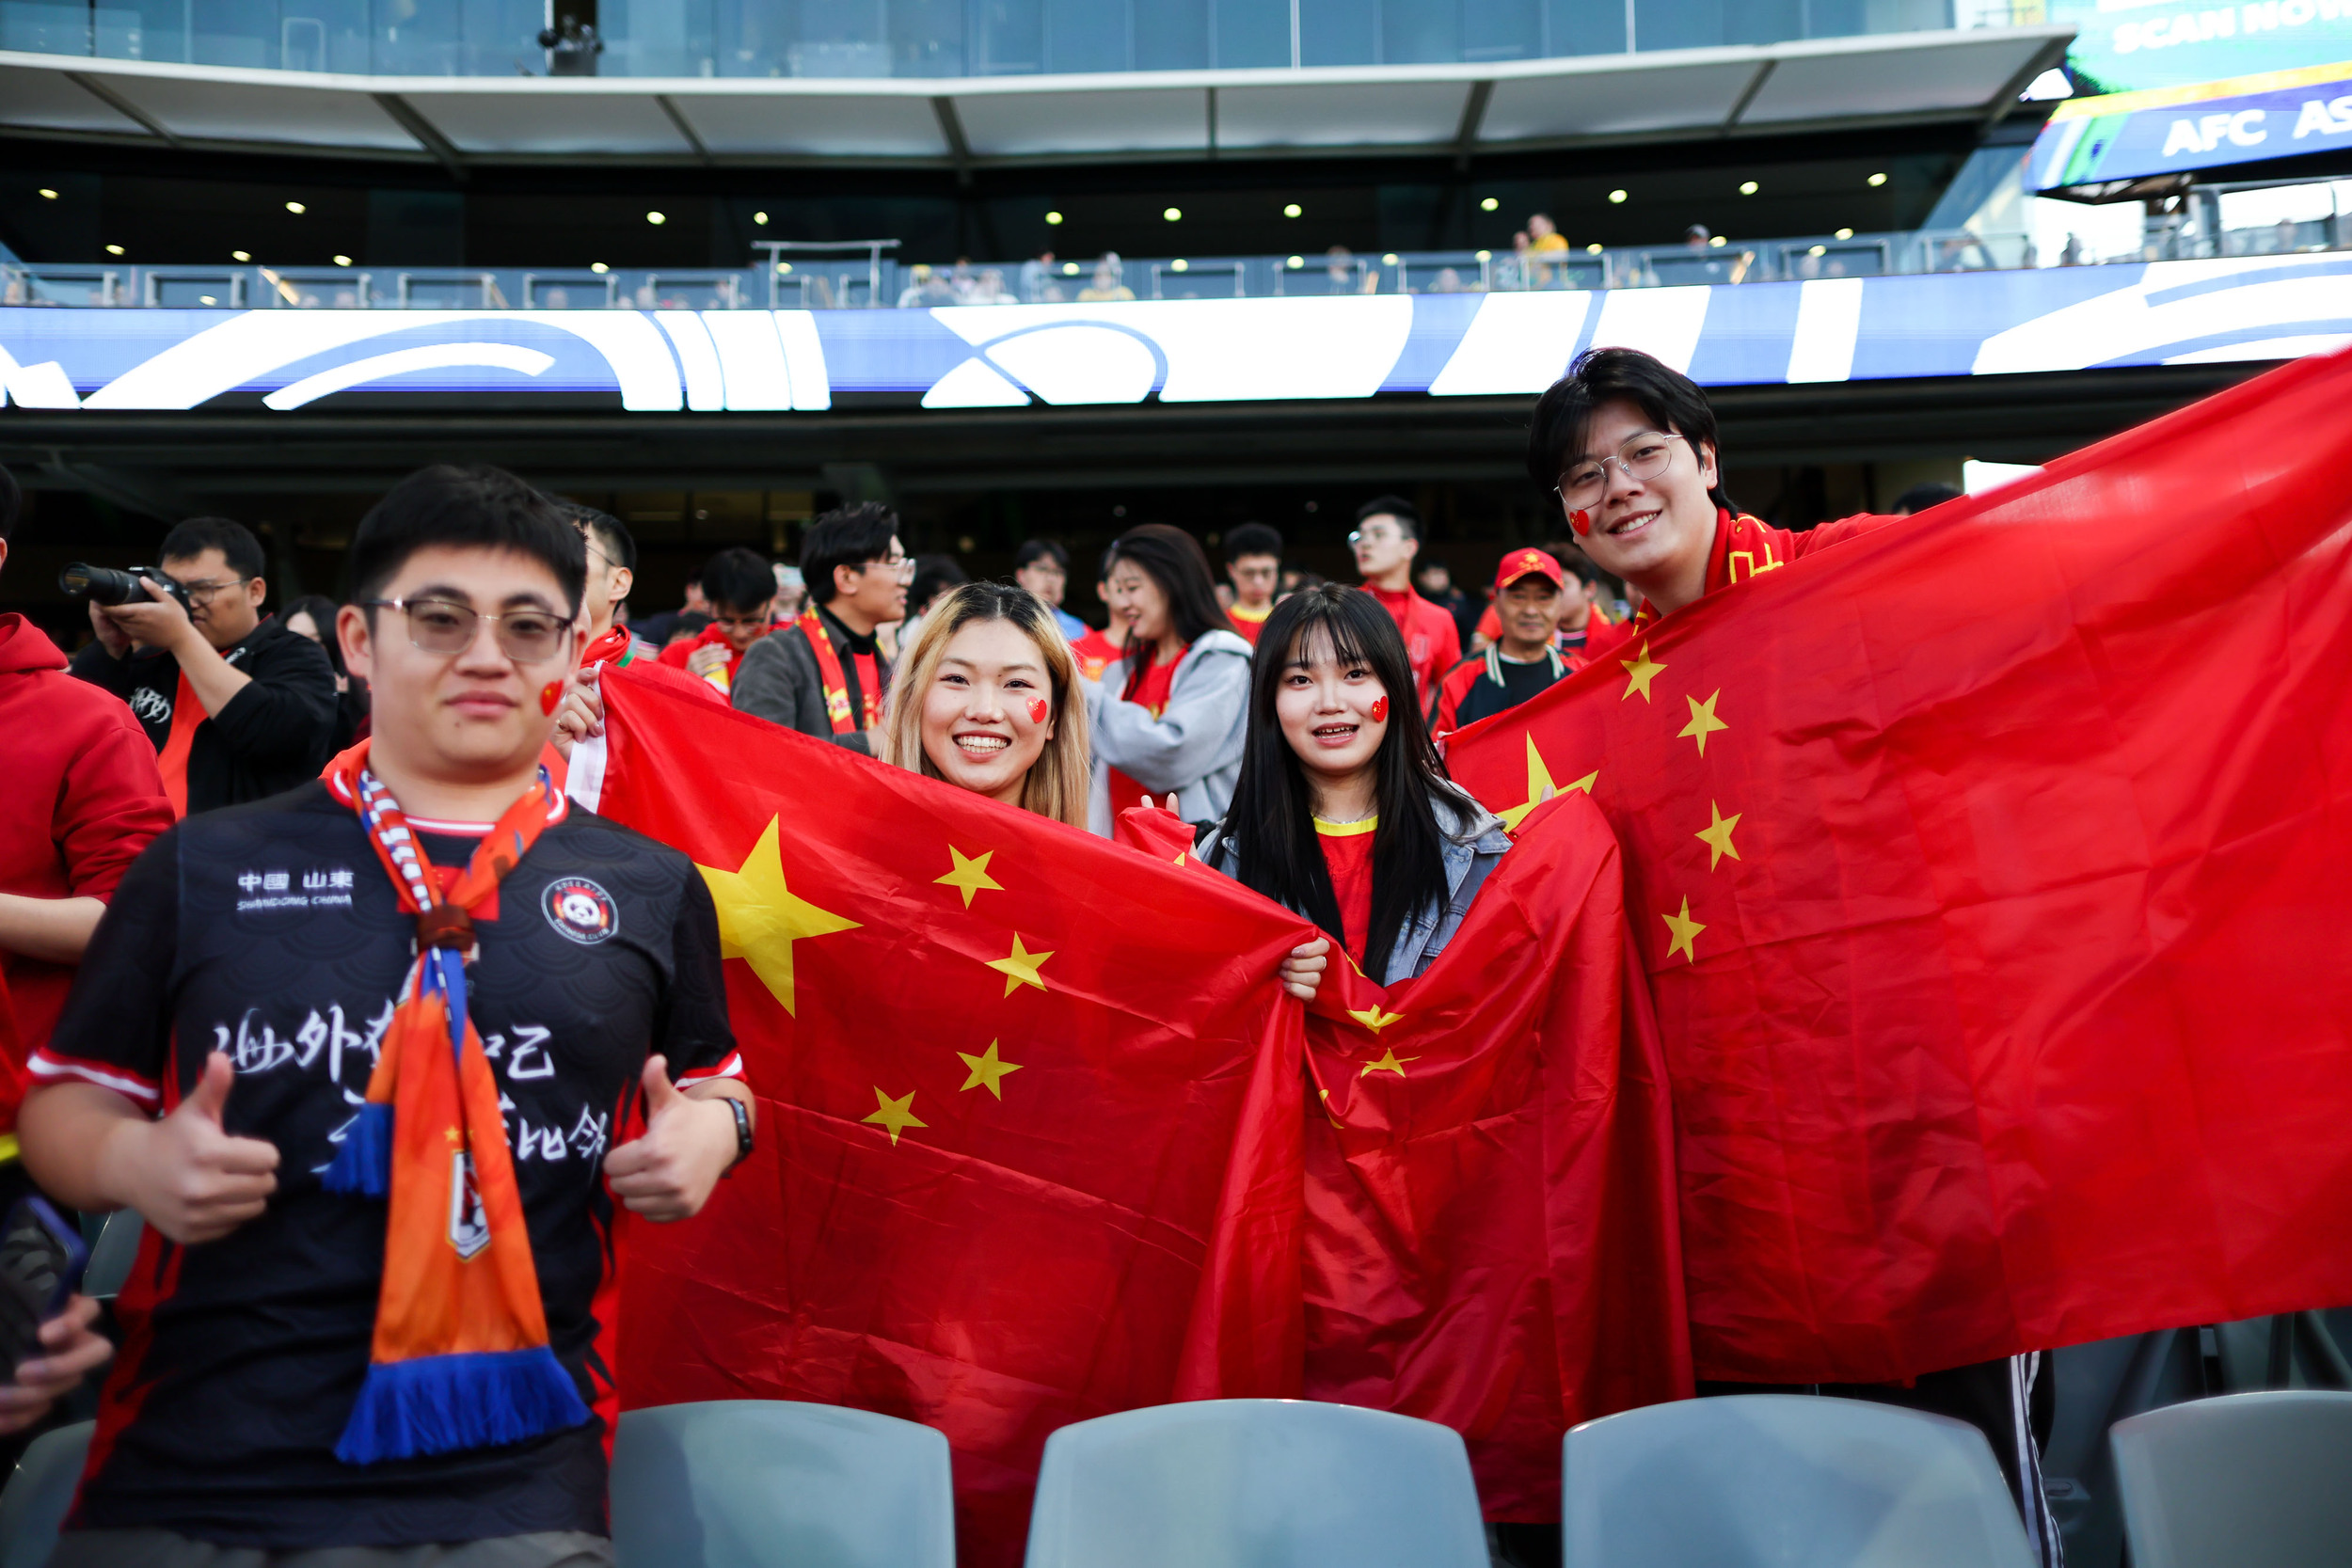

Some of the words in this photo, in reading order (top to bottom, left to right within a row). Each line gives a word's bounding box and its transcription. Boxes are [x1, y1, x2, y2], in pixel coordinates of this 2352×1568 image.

[2113, 7, 2236, 54] SCAN
[2162, 108, 2267, 157] AFC
[237, 872, 290, 893] 中國
[302, 870, 355, 889] 山東
